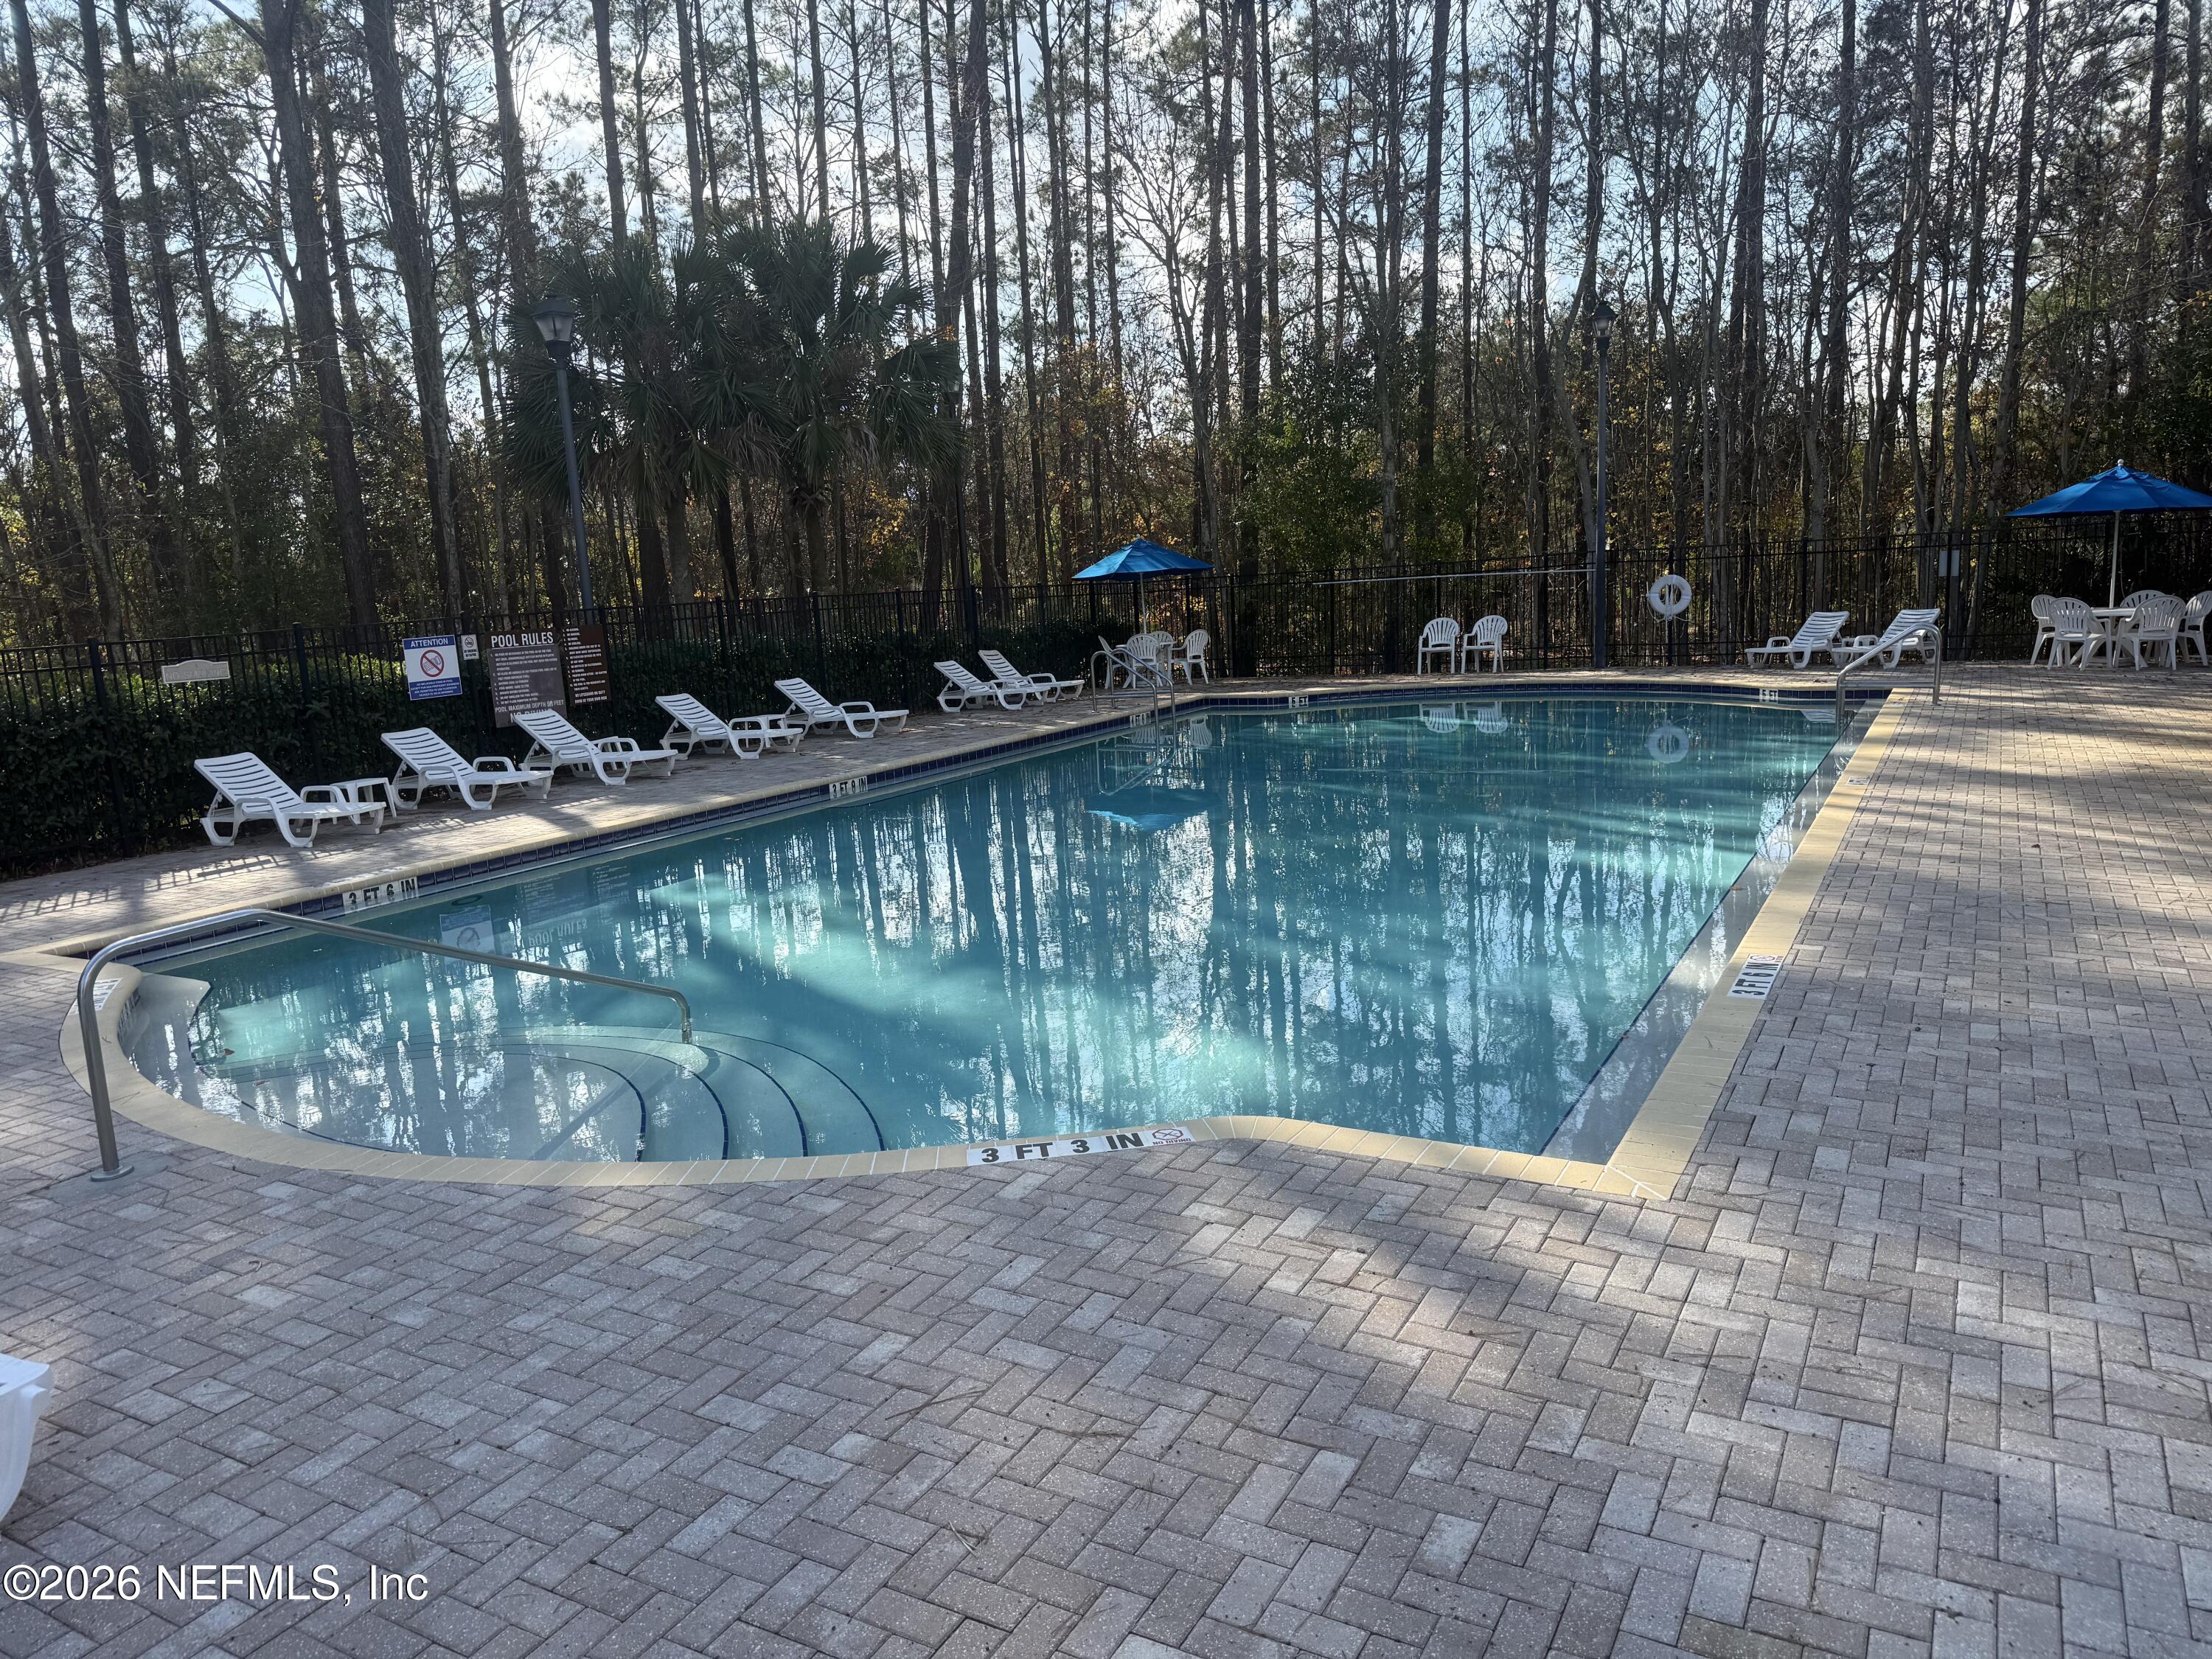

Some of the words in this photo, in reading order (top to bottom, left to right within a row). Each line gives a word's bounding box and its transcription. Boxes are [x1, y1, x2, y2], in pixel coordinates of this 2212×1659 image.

[411, 638, 448, 647] ATTENTION
[491, 634, 519, 648] POOL
[521, 632, 554, 645] RULES
[840, 782, 848, 794] FT
[859, 777, 867, 791] IN
[363, 886, 380, 902] FT
[386, 884, 394, 897] 6
[401, 878, 415, 892] IN
[1745, 962, 1779, 970] IN
[1735, 978, 1770, 989] FT
[981, 1147, 999, 1163] 3
[1016, 1142, 1053, 1159] FT
[1071, 1139, 1090, 1154] 3
[1106, 1133, 1144, 1150] IN
